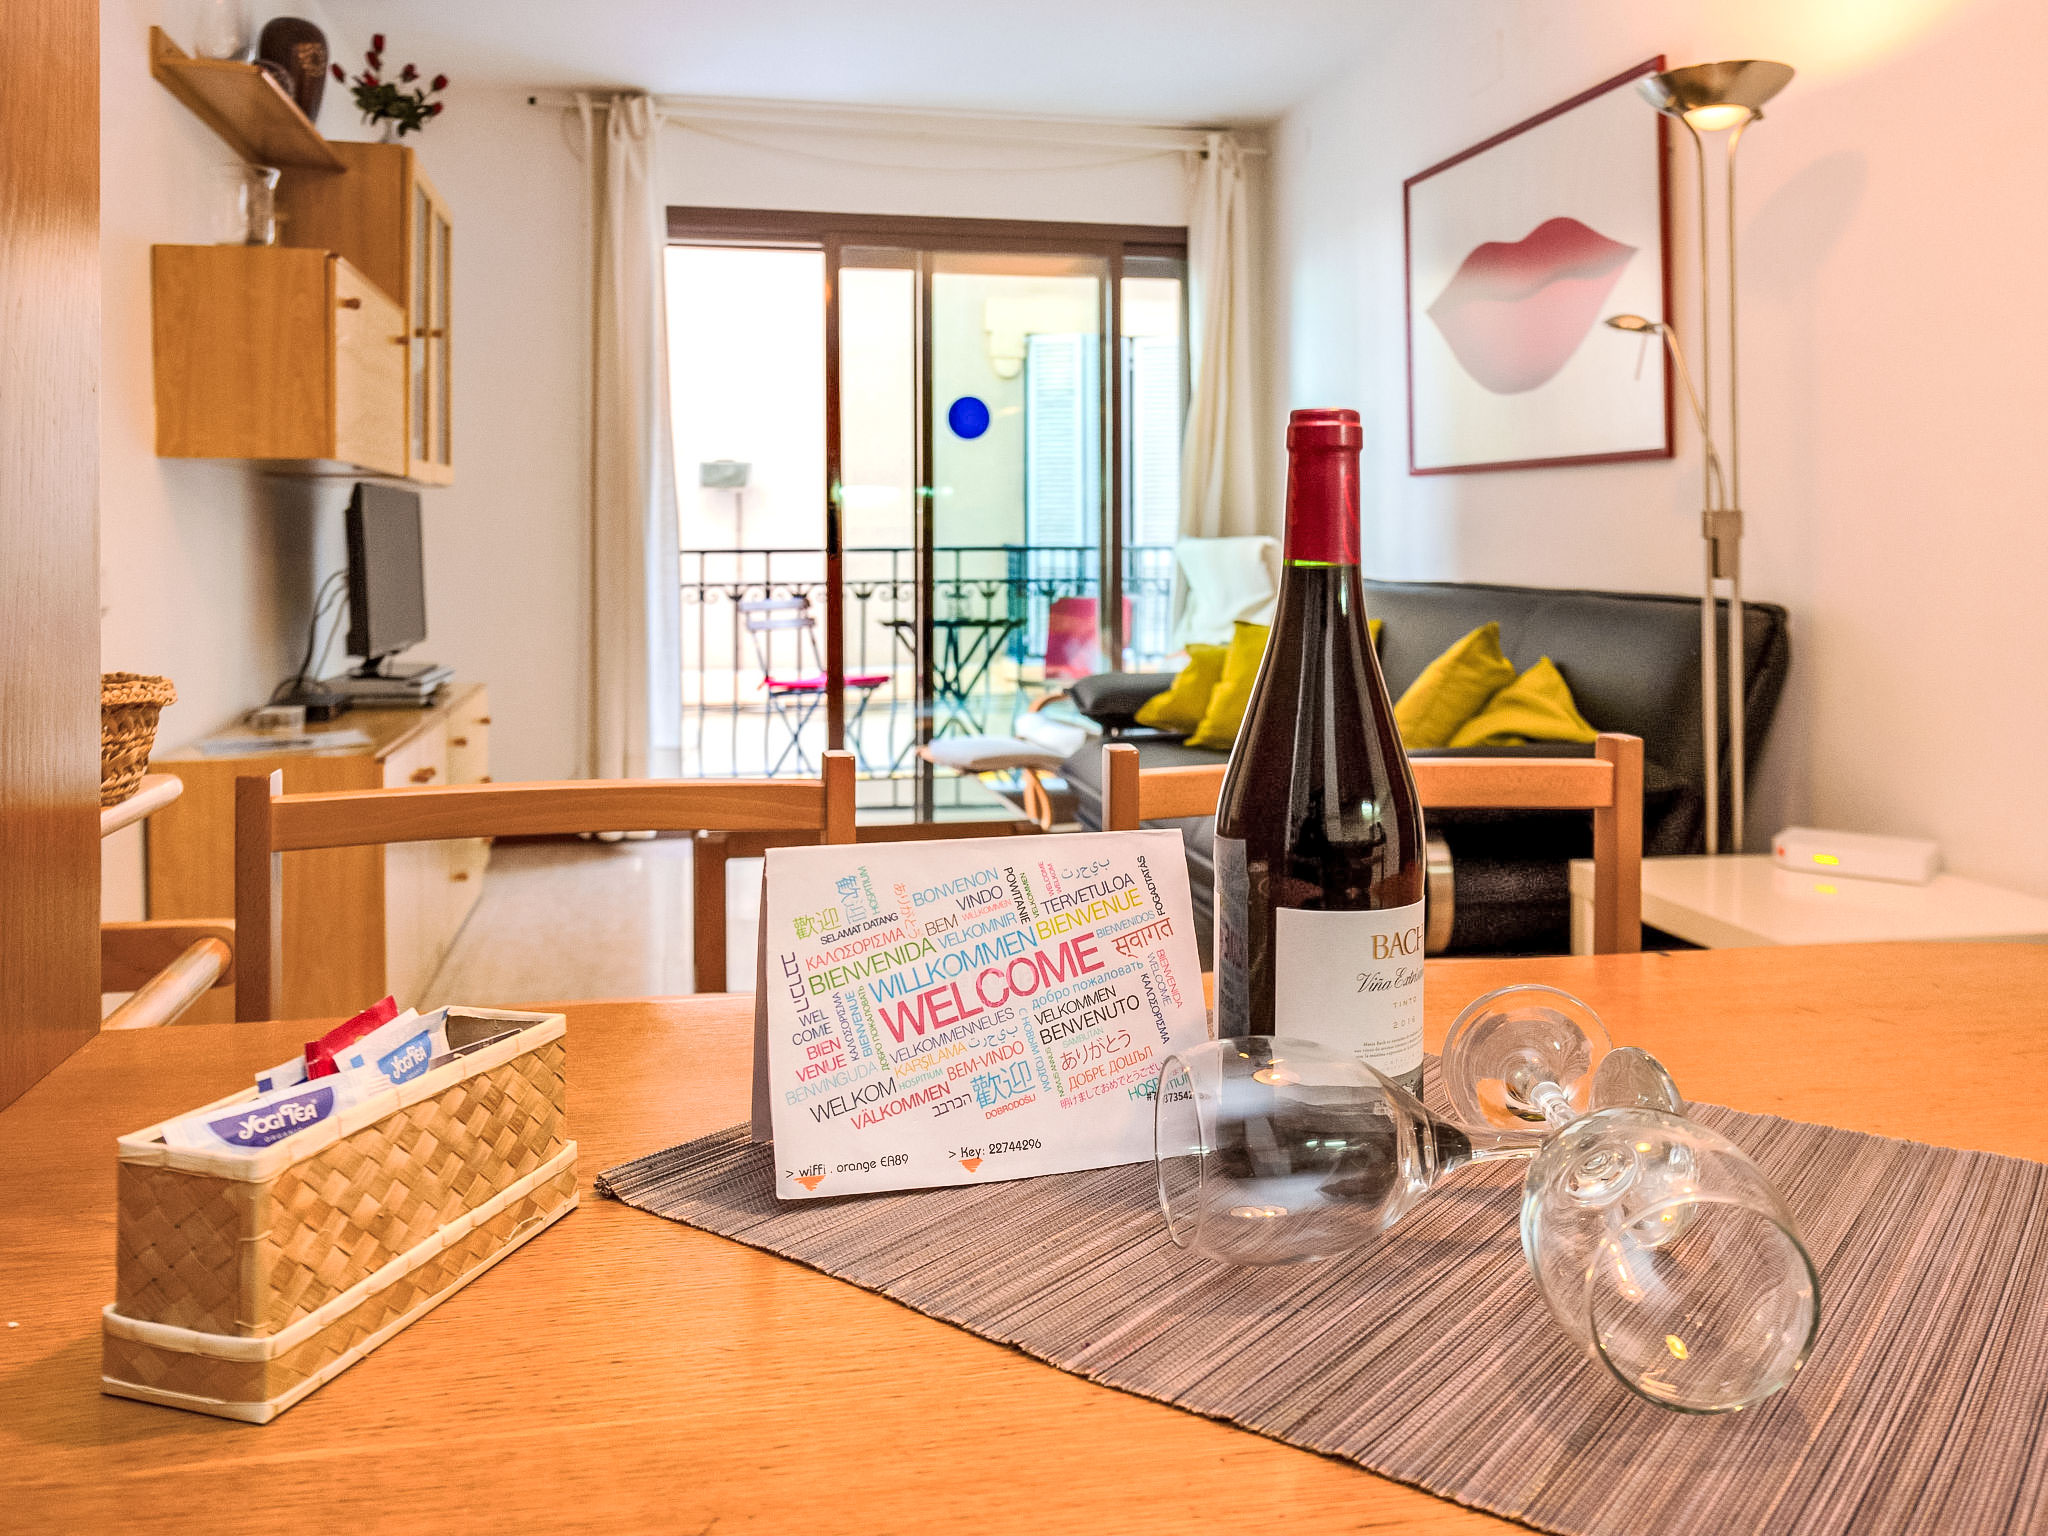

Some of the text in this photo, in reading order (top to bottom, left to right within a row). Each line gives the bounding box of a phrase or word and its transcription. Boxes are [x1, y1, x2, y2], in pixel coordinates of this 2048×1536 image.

[912, 867, 999, 907] BONVENON
[956, 885, 1003, 911] VINDO
[1004, 867, 1031, 924] POWITANIE
[1041, 873, 1135, 915] TERVETULOA
[820, 912, 898, 945] SELAMAT DATANG
[925, 914, 959, 936] BEM
[937, 912, 1018, 949] VELKOMNIR
[1036, 888, 1144, 940] BIENVENUE
[805, 928, 905, 971] ΚΑΛΩΣΟΡΙΣΜΑ
[1371, 923, 1424, 960] BACH
[808, 938, 937, 995] BIENVENIDA
[868, 926, 1038, 1004] WILLKOMMEN
[1147, 952, 1173, 1007] WELCOME
[1156, 948, 1183, 1009] BIENVENIDA
[1356, 967, 1391, 994] Viña
[878, 932, 1105, 1044] WELCOME
[1032, 960, 1144, 1011] добро пожаловать
[1034, 985, 1116, 1025] VELKOMMEN
[1392, 996, 1417, 1008] TINTO
[792, 1023, 832, 1045] COME
[799, 1009, 828, 1028] WEL
[845, 990, 873, 1057] BIENVENUE
[1039, 994, 1140, 1045] BENVENUTO
[391, 1045, 427, 1079] YOGI TEA
[796, 1054, 847, 1082] VENUE
[806, 1037, 841, 1061] BIEN
[947, 1039, 1025, 1082] BEM-VINDO
[1061, 1029, 1131, 1072] ありがとう
[785, 1061, 878, 1106] BENVINGUDA
[1069, 1064, 1105, 1092] ДОБРЕ
[810, 1076, 897, 1123] WELKOM
[851, 1081, 951, 1130] VÄLKOMMEN
[238, 1102, 318, 1140] YOGI TEA
[836, 1160, 876, 1173] orange
[989, 1138, 1042, 1155] 22744296
